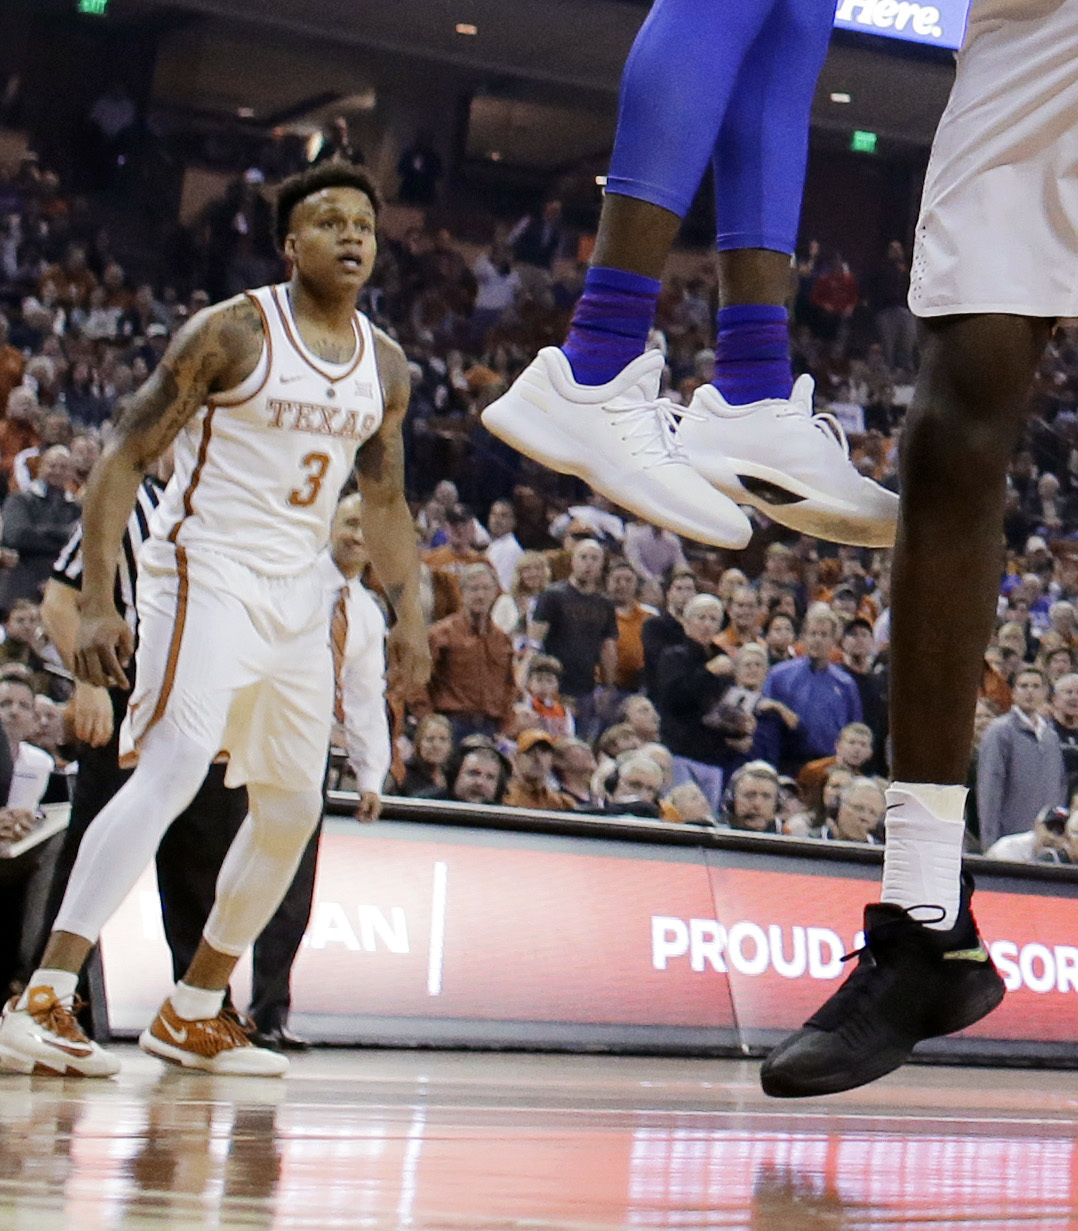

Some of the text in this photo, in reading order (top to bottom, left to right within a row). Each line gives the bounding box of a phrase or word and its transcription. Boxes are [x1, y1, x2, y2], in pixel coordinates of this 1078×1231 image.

[269, 399, 376, 439] TEXAS
[289, 452, 330, 506] 3
[650, 915, 846, 980] PROUD
